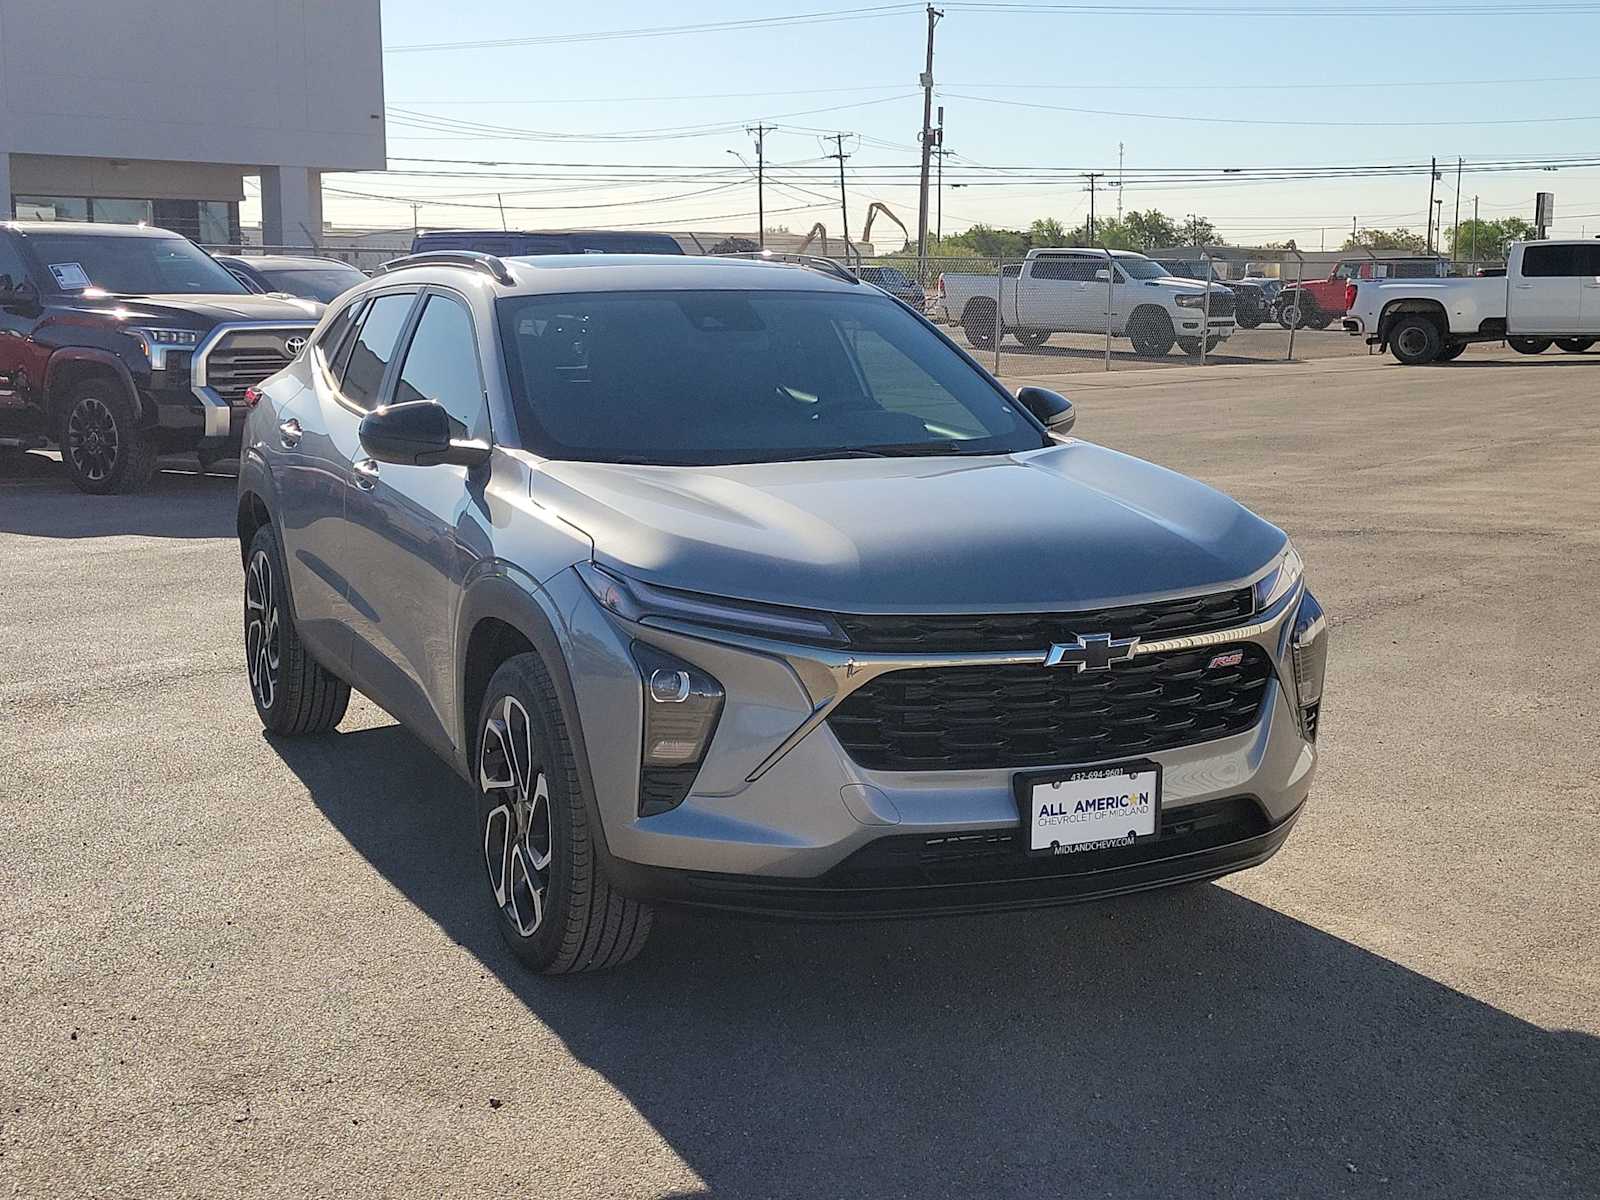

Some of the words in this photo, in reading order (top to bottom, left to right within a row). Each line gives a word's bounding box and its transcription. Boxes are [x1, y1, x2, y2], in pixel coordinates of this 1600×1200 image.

[1208, 654, 1243, 668] RS
[1038, 813, 1092, 827] CHEVROLET
[1095, 811, 1107, 820] OF
[1109, 805, 1149, 817] MIDLAND
[1039, 803, 1067, 818] ALL
[1054, 837, 1135, 855] MIDLANDCHEVY.COM
